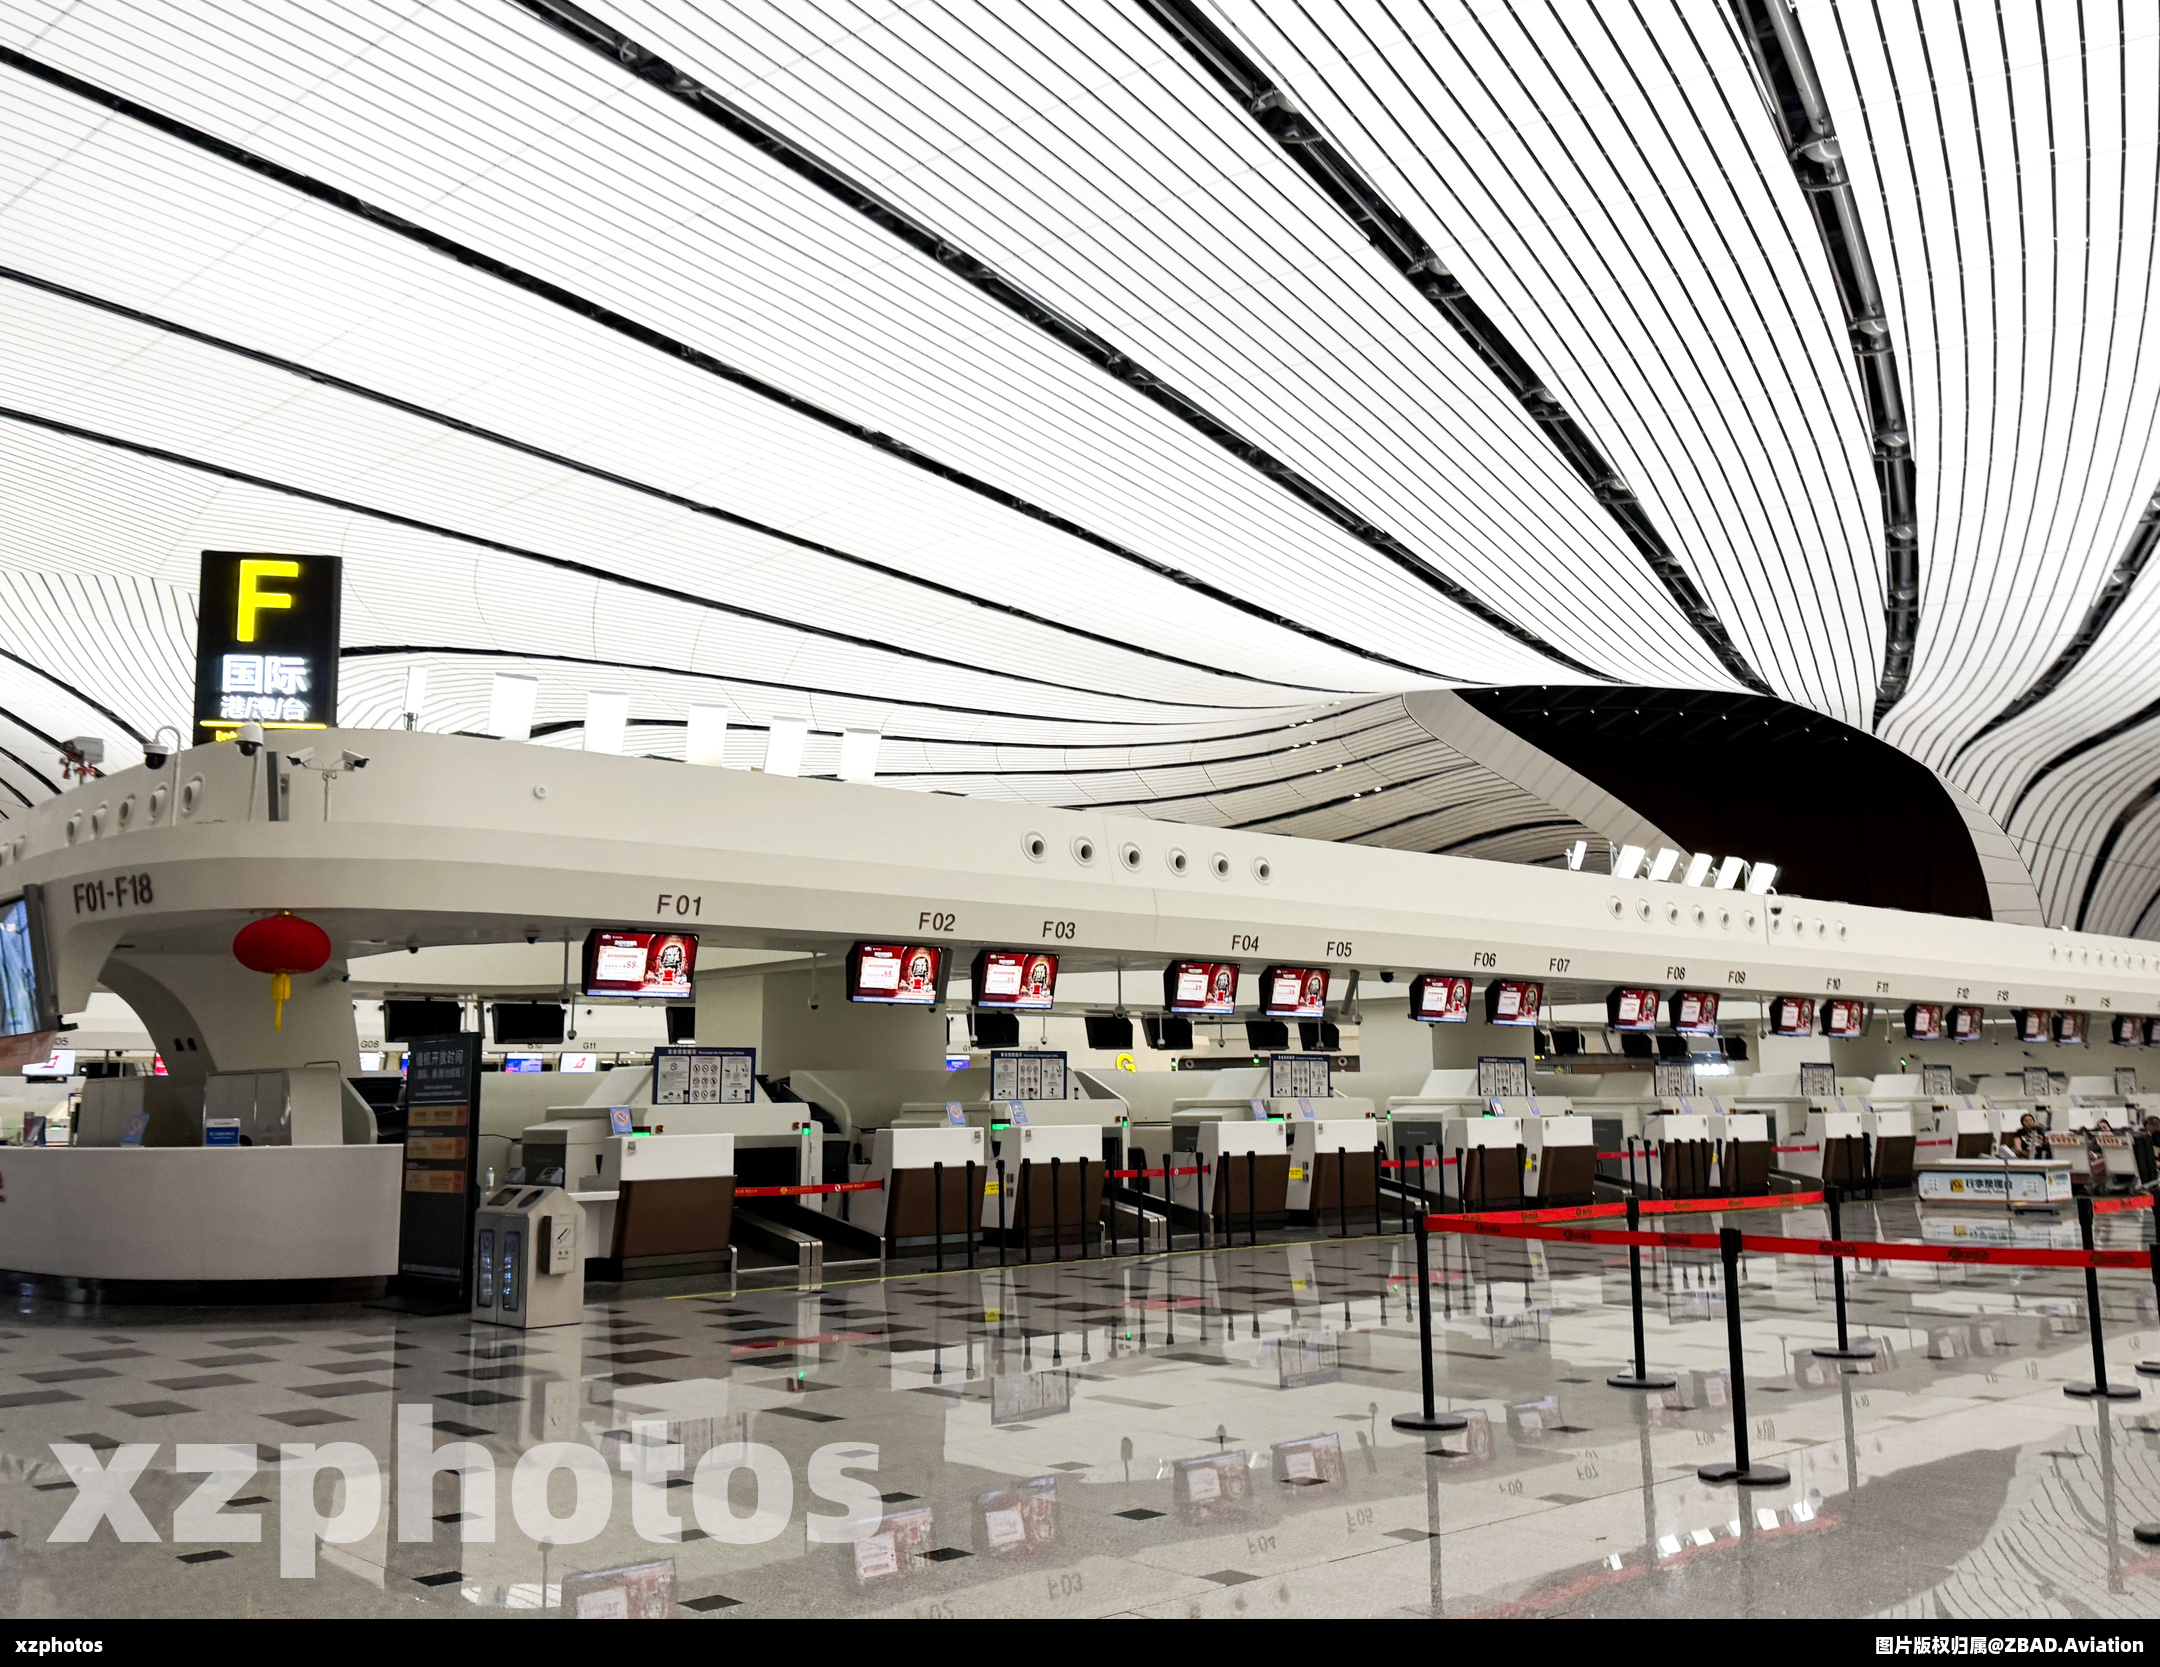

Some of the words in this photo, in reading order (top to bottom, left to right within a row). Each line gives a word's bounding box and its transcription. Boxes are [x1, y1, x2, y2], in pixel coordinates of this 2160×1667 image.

[237, 559, 299, 642] F
[222, 653, 309, 695] 国际
[73, 873, 153, 914] F01-F18
[657, 894, 701, 916] F01
[918, 911, 956, 932] F02
[1042, 920, 1076, 939] F03
[1231, 934, 1259, 952] F04
[1326, 941, 1352, 957] F05
[1473, 952, 1497, 967] F06
[1549, 957, 1570, 972] F07
[1666, 966, 1686, 980] F08
[1727, 970, 1746, 984] F09
[582, 1041, 596, 1050] G11
